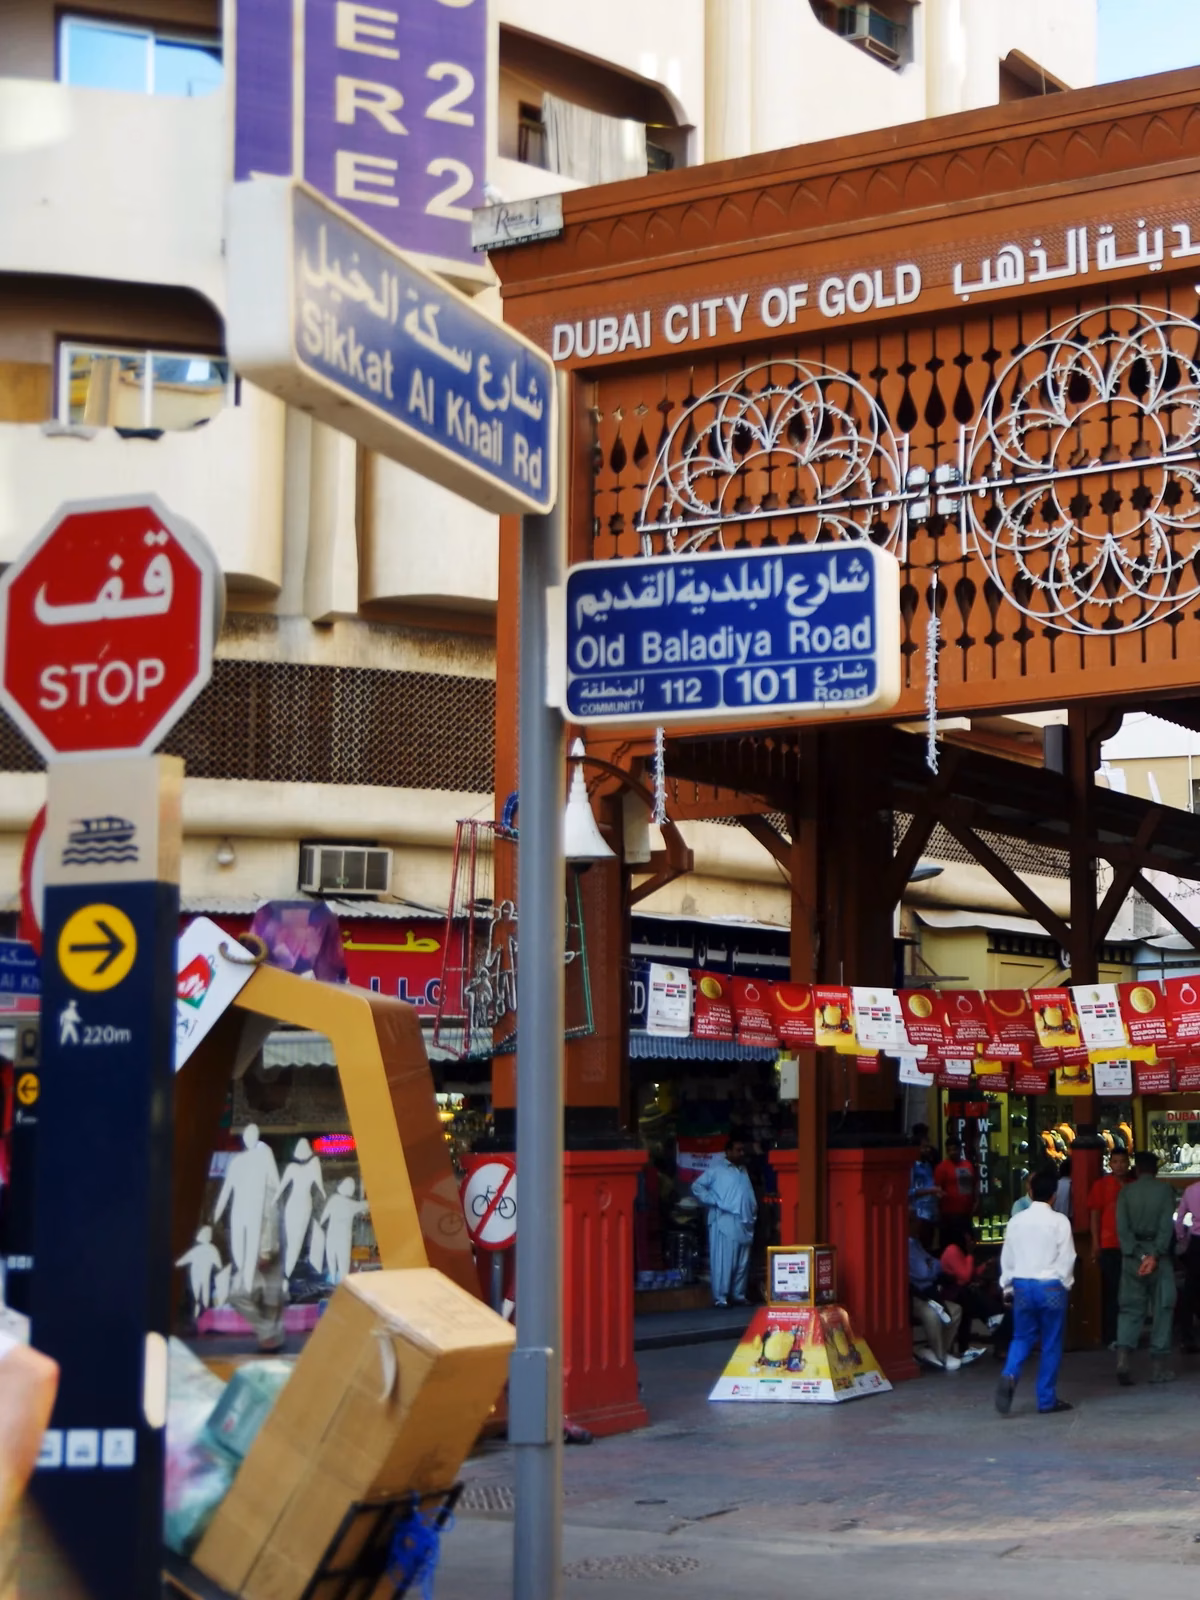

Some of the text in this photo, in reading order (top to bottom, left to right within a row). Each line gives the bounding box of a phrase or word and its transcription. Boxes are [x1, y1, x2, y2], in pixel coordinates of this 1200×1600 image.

[424, 0, 476, 222] 22
[953, 226, 1089, 303] الذهب
[303, 224, 543, 421] شارع سكة الخيل
[552, 263, 923, 362] DUBAI CITY OF GOLD
[303, 300, 542, 490] Sikkat Al Khail Rd
[34, 529, 174, 626] قف
[676, 557, 784, 616] البلدية
[785, 555, 870, 617] شارع
[576, 615, 872, 670] Old Baladiya Road
[39, 657, 166, 711] STOP
[579, 677, 645, 701] المنطقة
[660, 677, 703, 704] 112
[736, 666, 798, 702] 101
[813, 662, 869, 687] شارع
[813, 683, 869, 701] Road
[579, 700, 645, 716] COMMUNITY
[82, 1024, 133, 1045] 220m
[1166, 1111, 1200, 1122] DUBAI
[977, 1118, 989, 1194] WATCH
